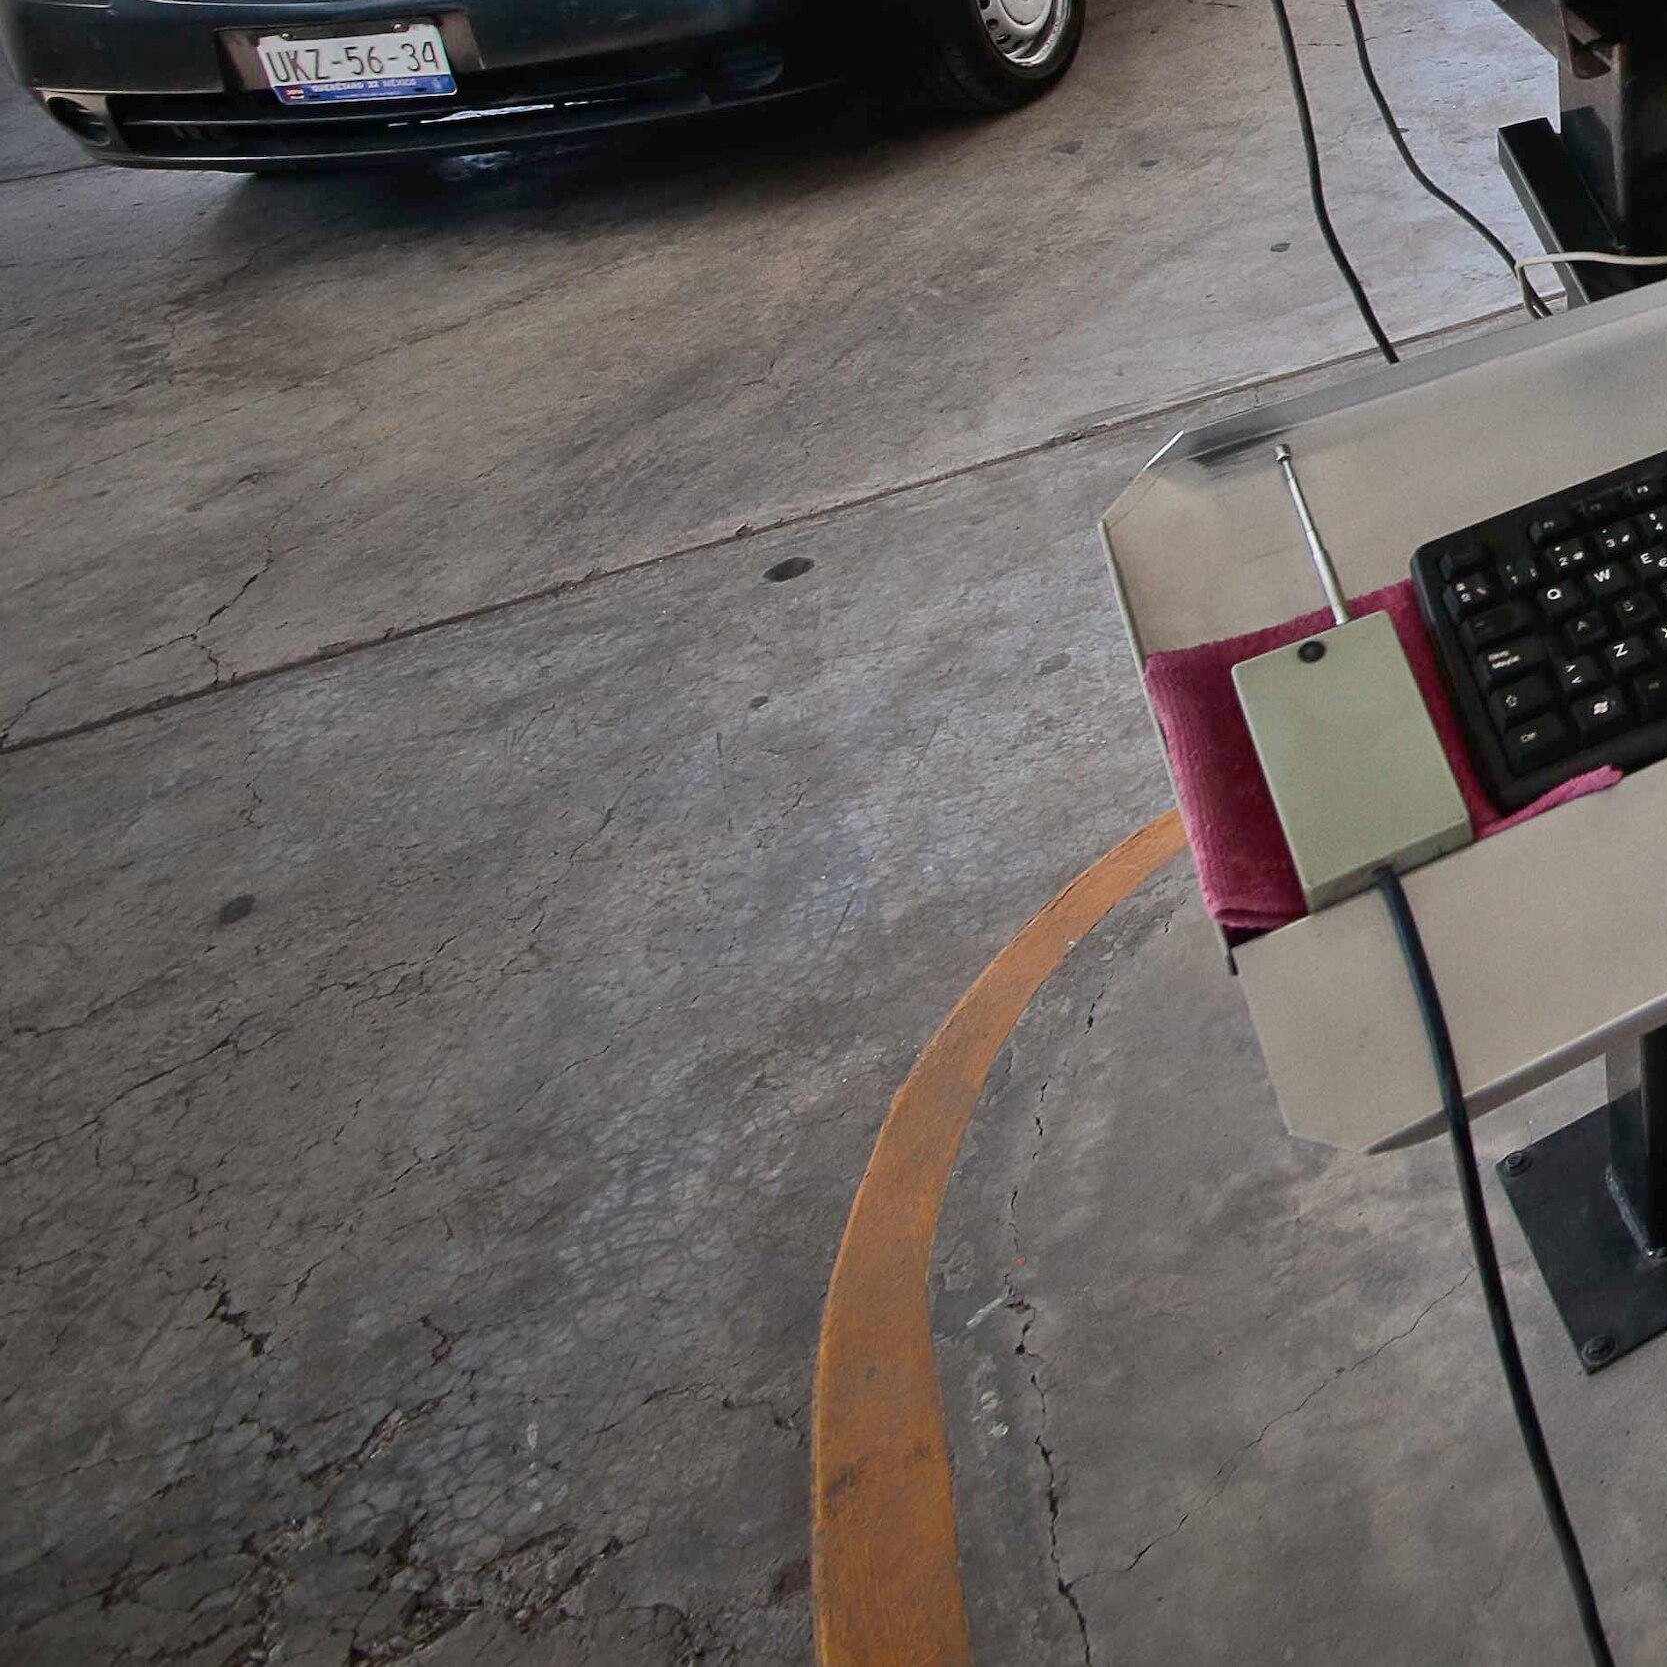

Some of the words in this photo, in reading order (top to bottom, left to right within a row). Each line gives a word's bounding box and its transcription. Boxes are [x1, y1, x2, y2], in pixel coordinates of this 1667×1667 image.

[1640, 553, 1653, 564] E
[1594, 569, 1610, 582] W
[1613, 643, 1628, 657] Z
